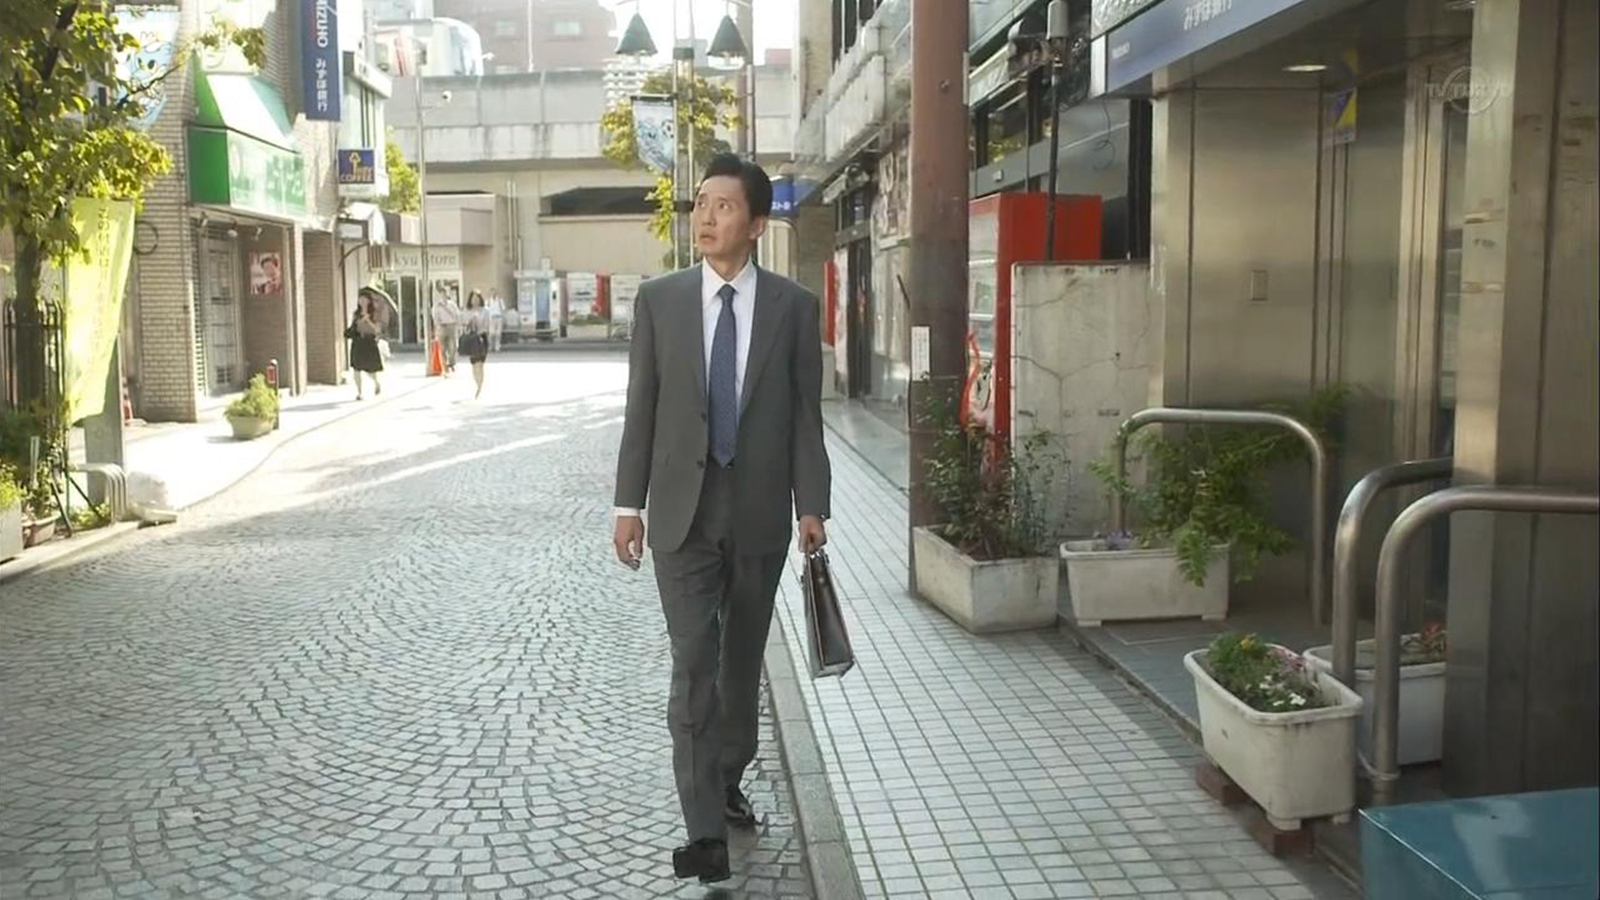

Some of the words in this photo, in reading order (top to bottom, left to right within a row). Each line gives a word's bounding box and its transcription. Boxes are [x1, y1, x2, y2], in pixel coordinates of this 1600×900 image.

[316, 58, 328, 112] みずほ銀行
